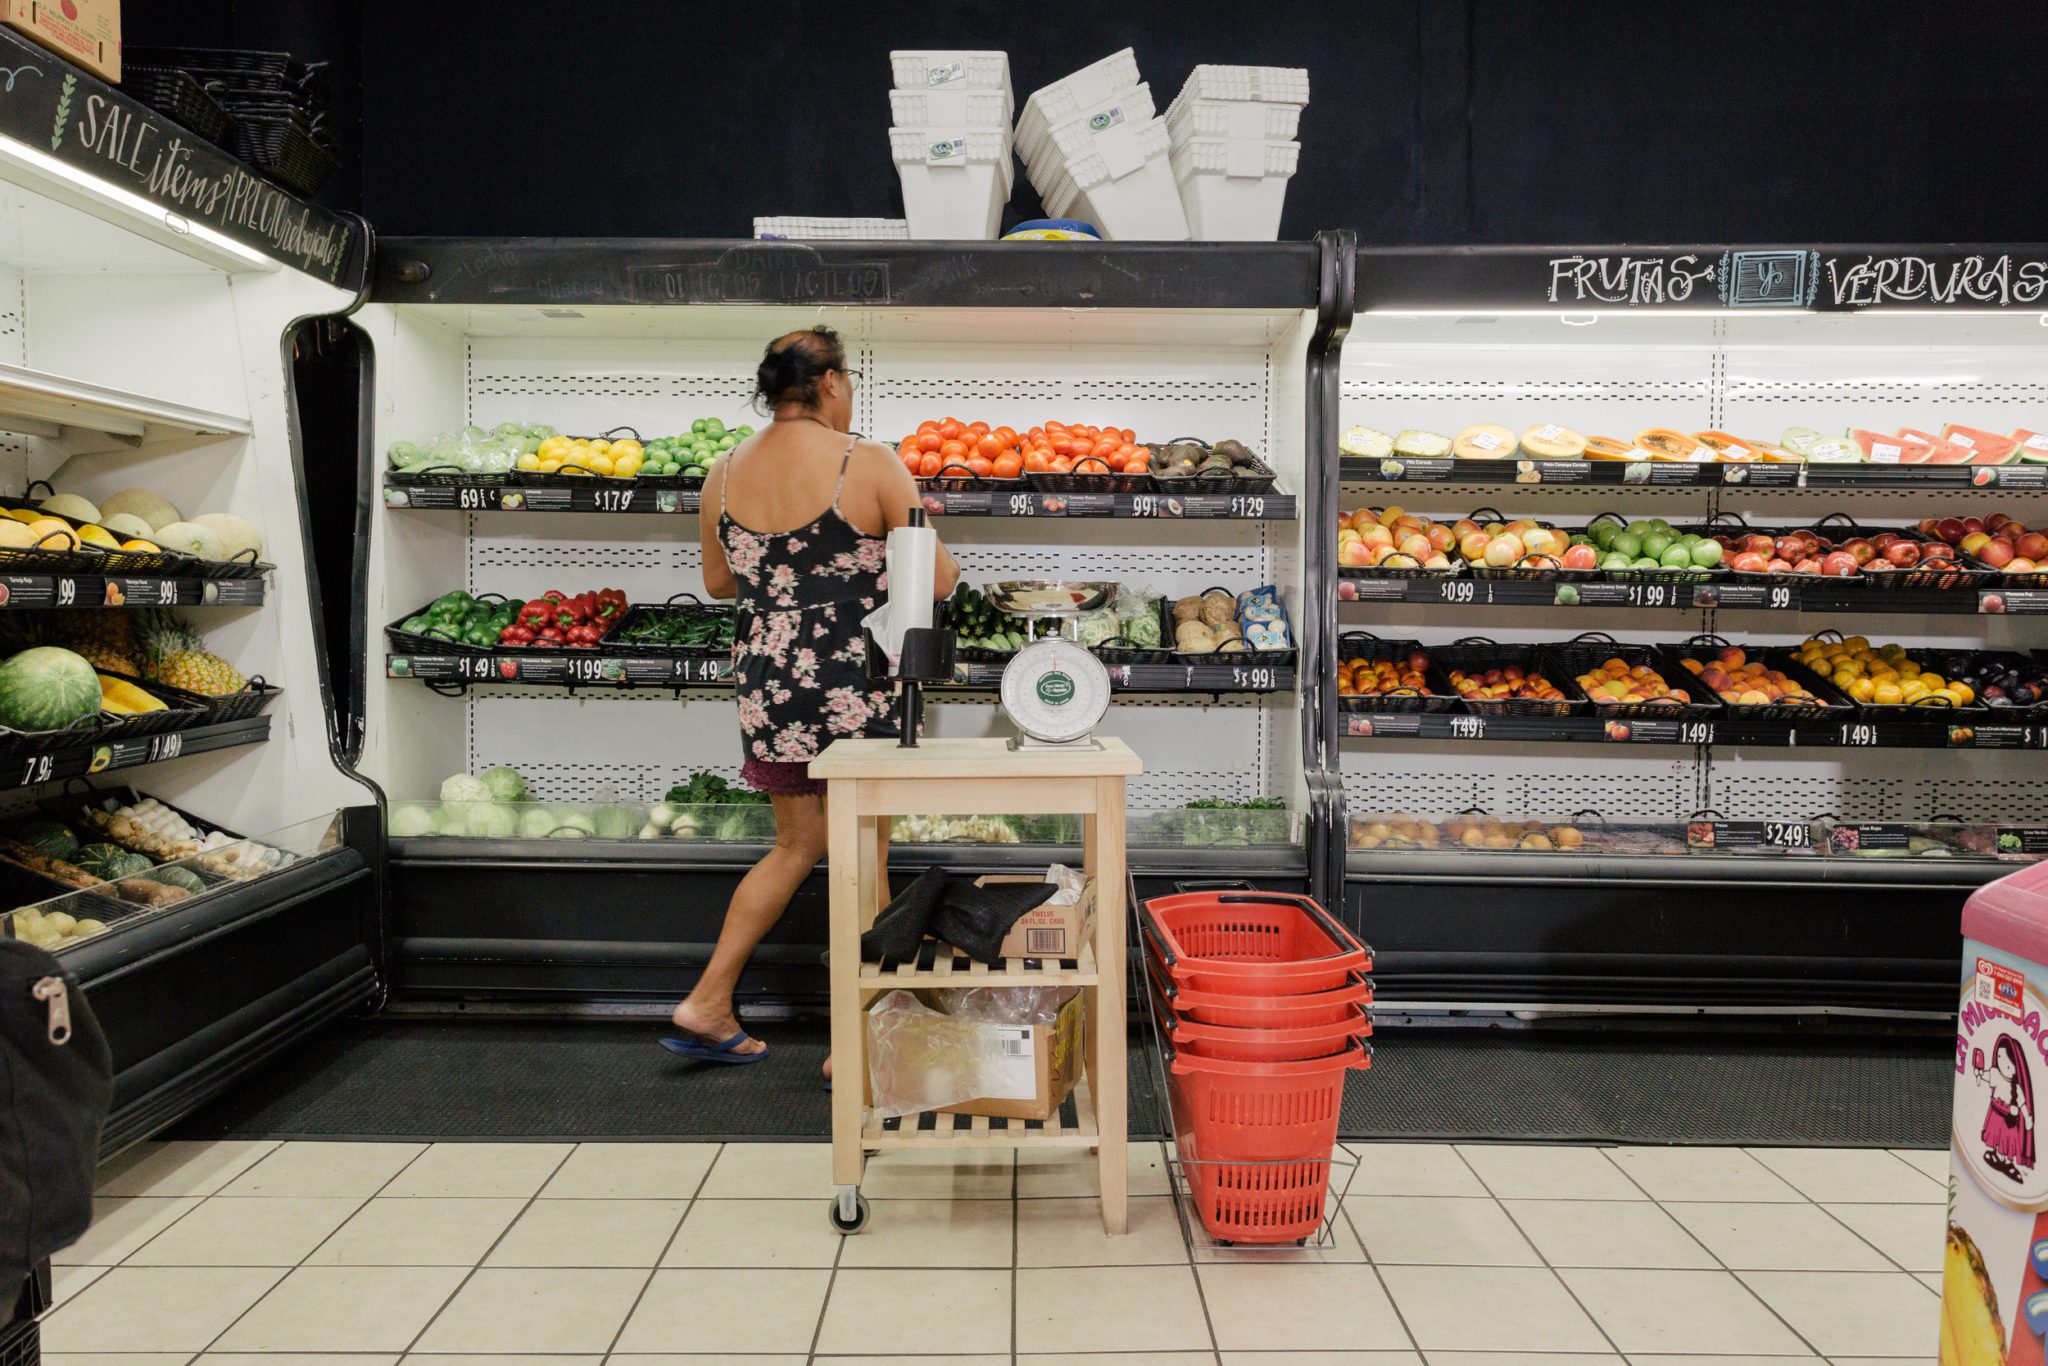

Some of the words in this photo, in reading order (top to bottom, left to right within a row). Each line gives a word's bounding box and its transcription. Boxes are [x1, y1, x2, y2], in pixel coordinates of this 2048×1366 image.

[78, 95, 159, 177] SALE
[139, 138, 232, 215] items
[1549, 255, 1714, 304] FRUTAS
[1826, 255, 2048, 305] VERDURAS
[1440, 581, 1474, 602] $0.99
[1628, 584, 1664, 606] $1.99
[1770, 587, 1790, 608] .99
[1681, 722, 1706, 743] 1.49
[1842, 724, 1870, 745] 1.49
[1767, 823, 1801, 846] $2.49
